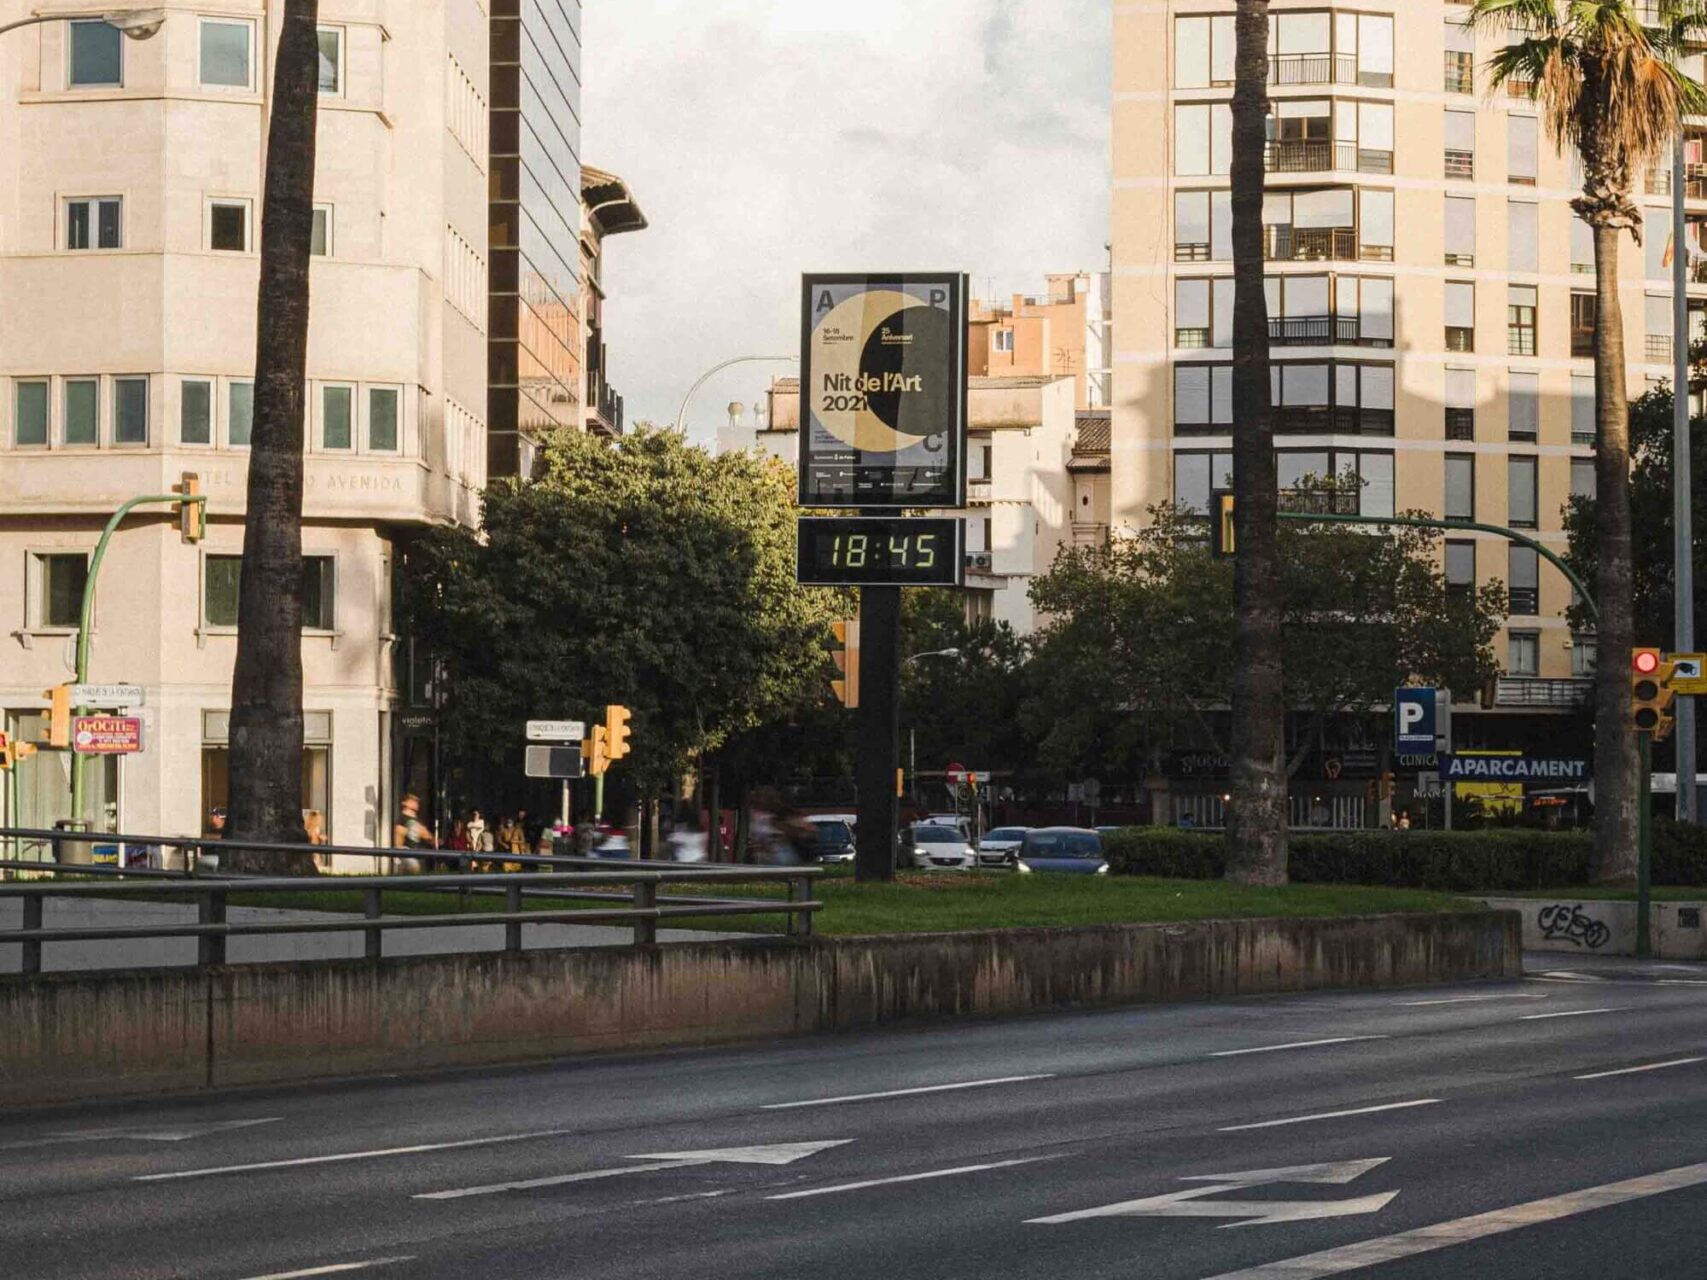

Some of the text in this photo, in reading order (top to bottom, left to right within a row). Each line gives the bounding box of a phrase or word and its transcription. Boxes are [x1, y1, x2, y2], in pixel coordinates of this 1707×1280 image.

[816, 290, 835, 312] A
[929, 289, 946, 308] P
[824, 373, 851, 391] Nit
[855, 372, 881, 391] de
[822, 395, 867, 411] 2021
[923, 433, 943, 452] C
[328, 473, 401, 490] AVENIDA
[832, 534, 935, 567] 18:45
[1400, 702, 1424, 734] P
[1449, 759, 1585, 776] APARCAMENT
